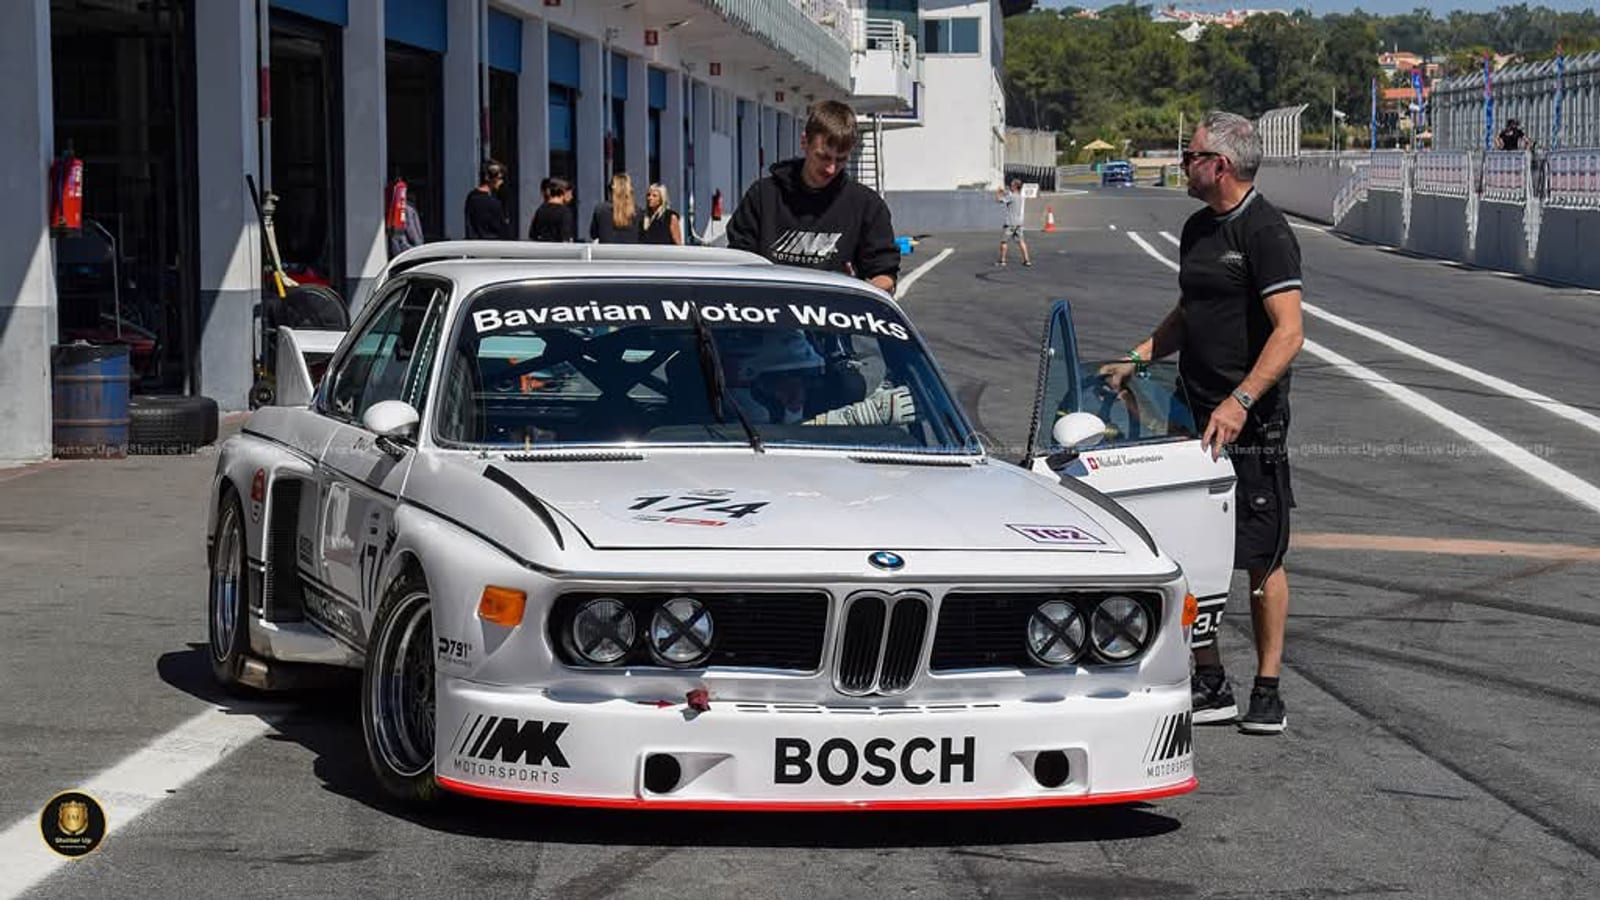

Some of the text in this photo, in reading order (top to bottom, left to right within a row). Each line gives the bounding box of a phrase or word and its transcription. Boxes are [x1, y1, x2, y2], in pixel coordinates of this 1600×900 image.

[472, 300, 910, 341] Bavarian Motor Works
[628, 496, 771, 518] 174
[453, 759, 560, 784] MOTORSPORTS
[774, 736, 976, 786] BOSCH
